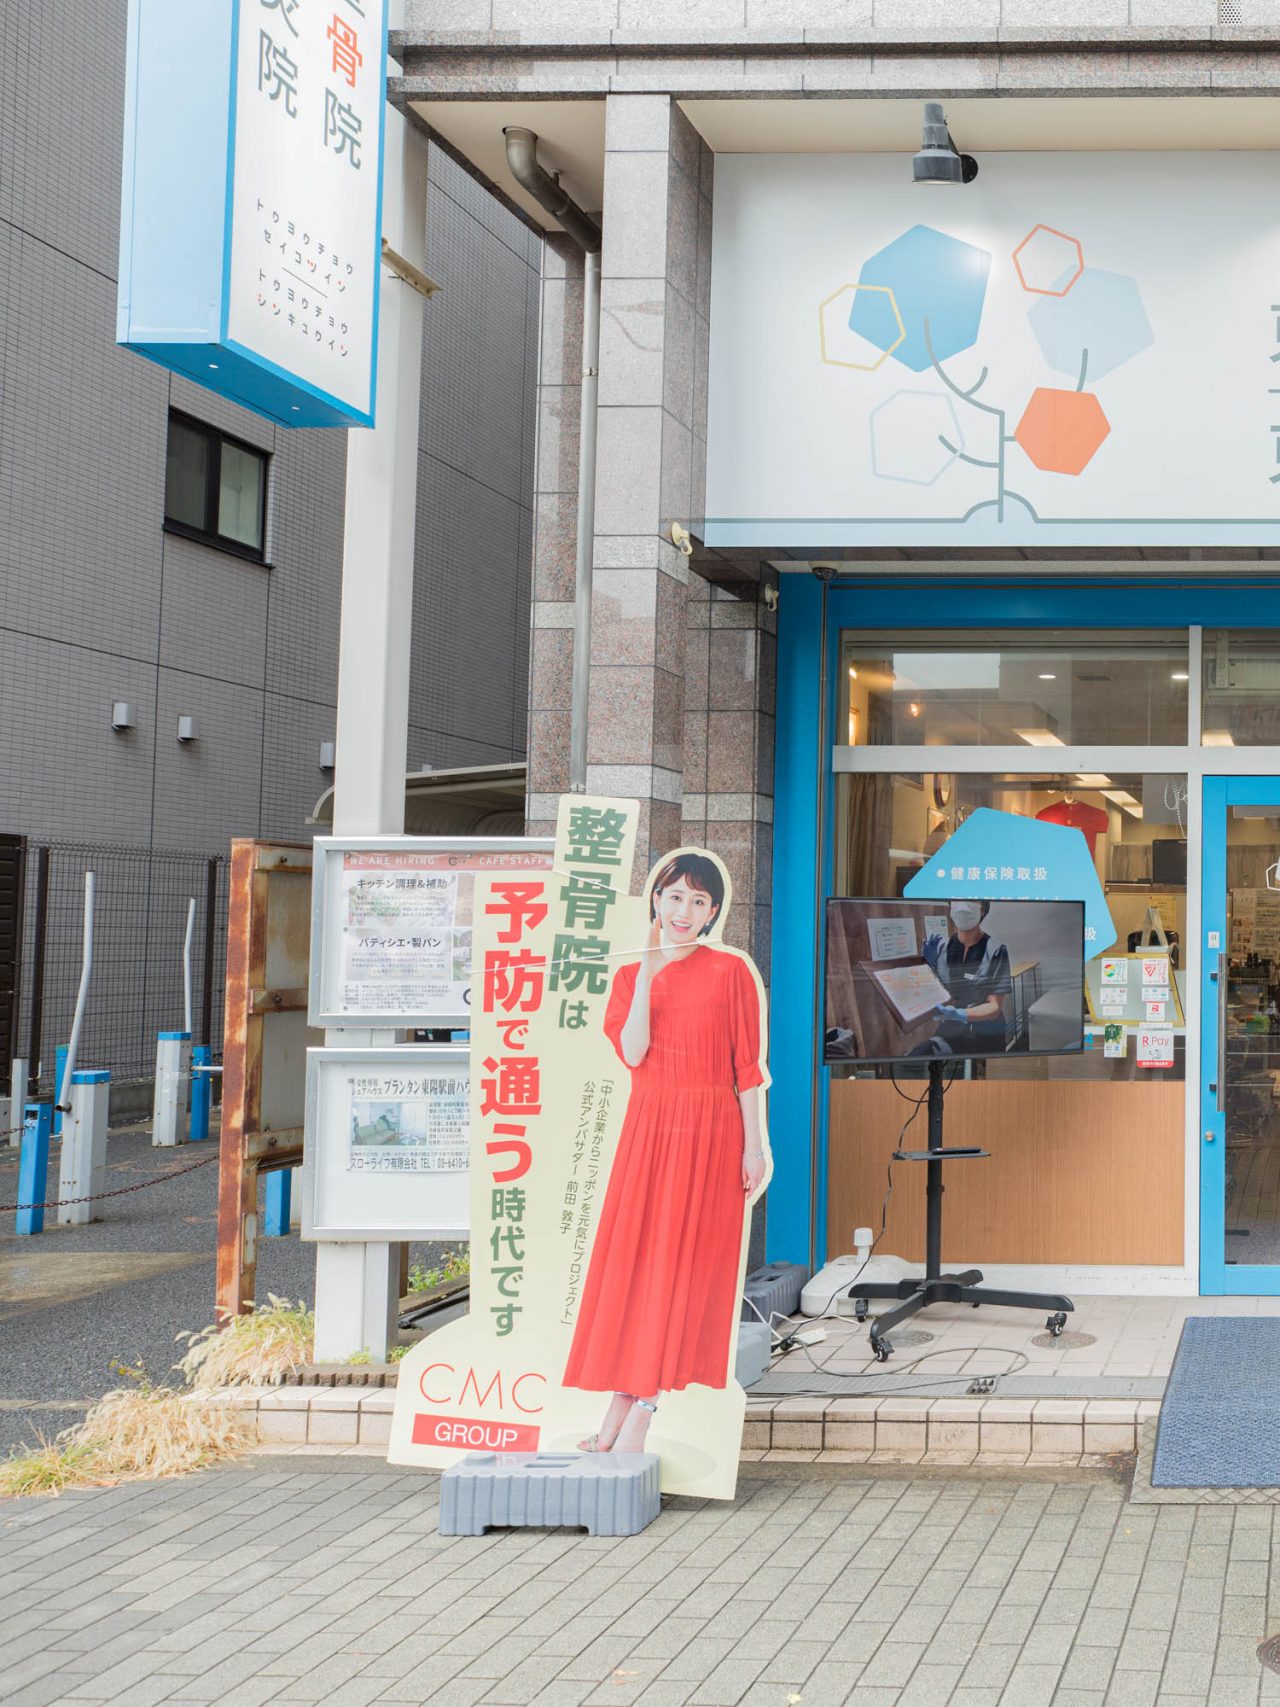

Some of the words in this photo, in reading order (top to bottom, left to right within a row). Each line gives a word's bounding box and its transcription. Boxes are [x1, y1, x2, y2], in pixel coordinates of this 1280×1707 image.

[323, 0, 365, 170] 骨院
[350, 856, 364, 865] WE
[369, 856, 390, 865] ARE
[395, 856, 435, 865] HIRING
[479, 856, 505, 865] CAFE
[510, 856, 544, 865] STAFF
[951, 867, 1048, 881] 健康保険取扱
[357, 878, 448, 889] キッチン調理&補助
[548, 806, 628, 1030] 整骨院は
[359, 937, 442, 948] パティシエ・製パン
[480, 881, 549, 1338] 予防で通う時代です
[573, 1081, 596, 1175] 公式アンバサダー
[419, 1363, 547, 1413] CMC
[434, 1421, 518, 1448] GROUP
